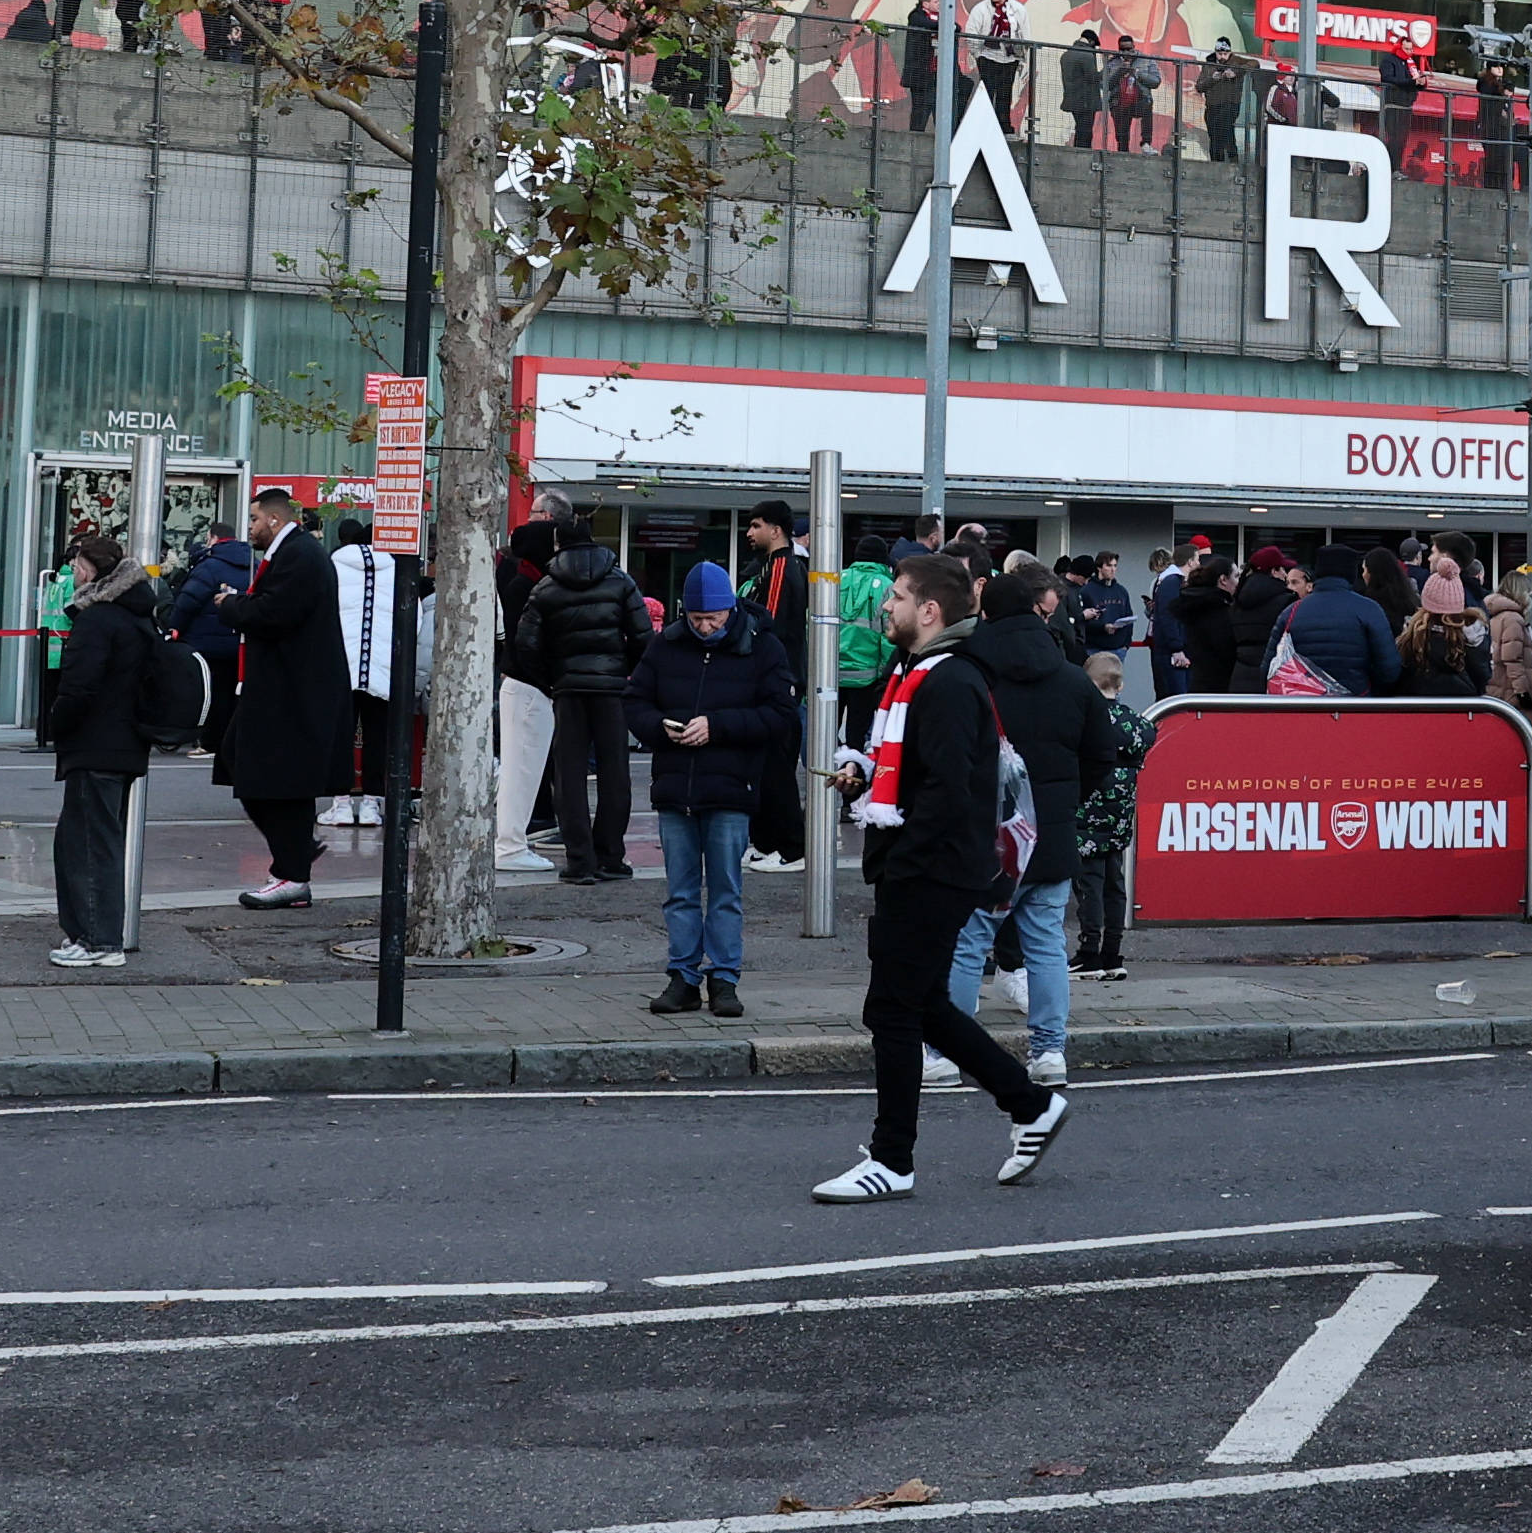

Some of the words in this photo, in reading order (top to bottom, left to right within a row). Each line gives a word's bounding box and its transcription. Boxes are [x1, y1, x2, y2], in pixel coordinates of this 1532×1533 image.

[1269, 5, 1409, 43] CHPMAN'S
[107, 411, 177, 431] MEDIA
[80, 430, 205, 453] ENTRNCE
[1347, 432, 1422, 478] BOX
[1431, 435, 1525, 481] OFFIC
[1186, 778, 1301, 791] CHAMPIONS
[1311, 778, 1333, 790] OF
[1341, 778, 1417, 789] EUROPE
[1425, 777, 1484, 790] 24/25
[1157, 801, 1326, 852] ARSENAL
[1375, 800, 1507, 850] WOMEN
[1336, 810, 1365, 819] Arsenal
